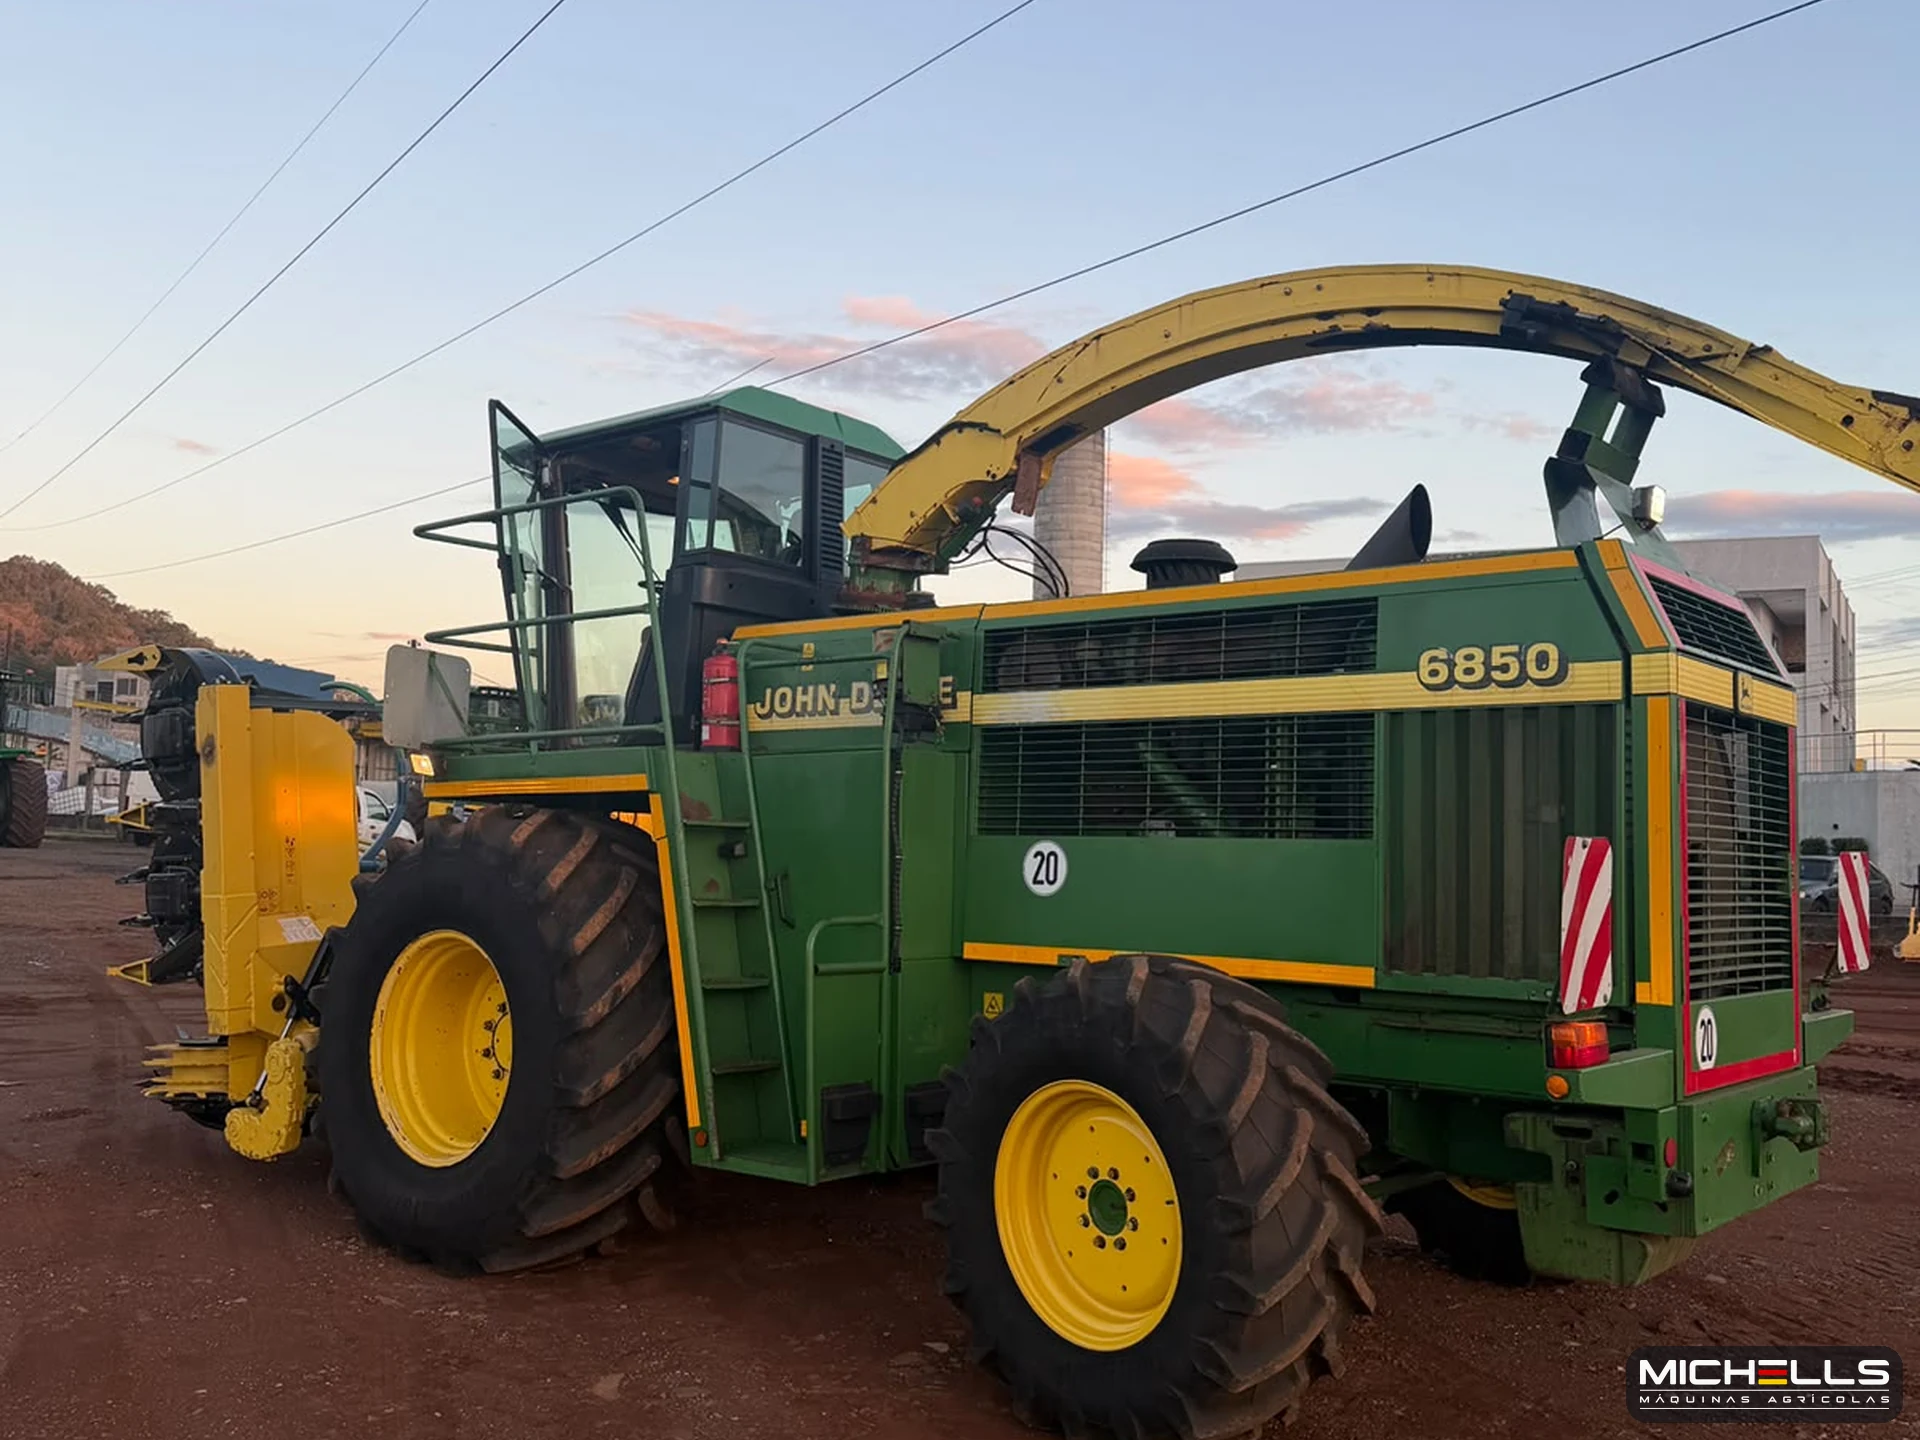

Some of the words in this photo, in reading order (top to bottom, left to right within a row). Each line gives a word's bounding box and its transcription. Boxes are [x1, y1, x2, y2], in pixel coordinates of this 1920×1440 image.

[1417, 640, 1569, 691] 6850
[755, 682, 840, 720] JOHN
[1032, 850, 1058, 886] 20
[1700, 1018, 1713, 1063] 20
